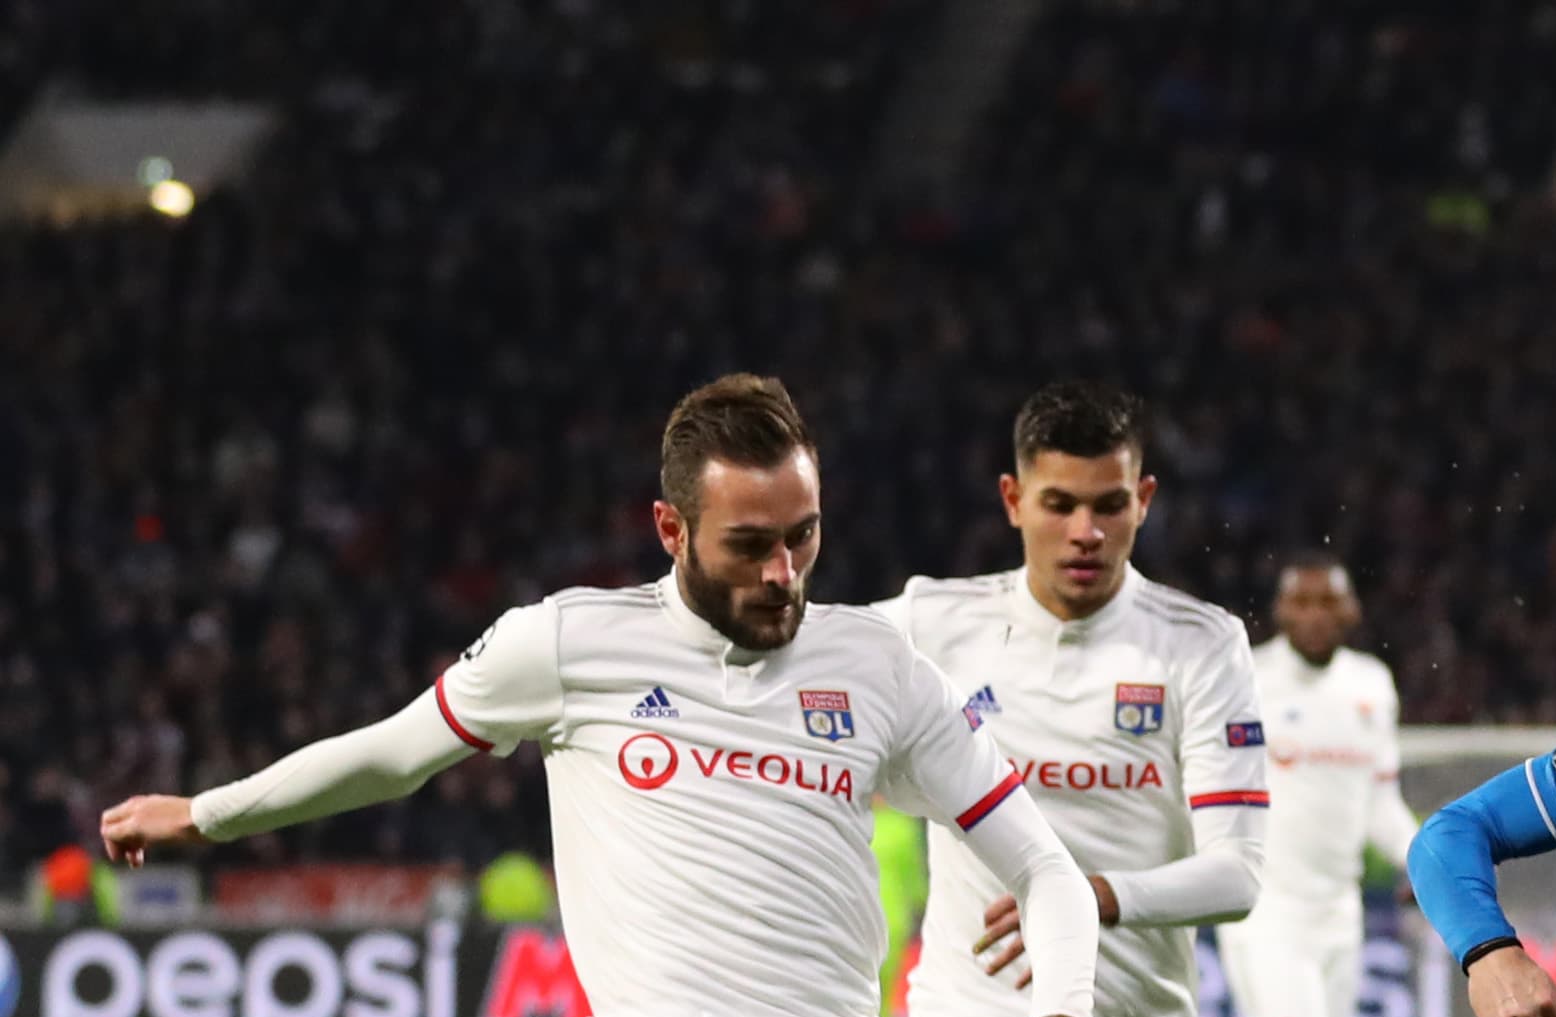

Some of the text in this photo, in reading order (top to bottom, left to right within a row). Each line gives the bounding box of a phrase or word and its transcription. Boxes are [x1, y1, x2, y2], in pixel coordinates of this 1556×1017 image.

[630, 705, 680, 719] adidas
[690, 748, 853, 803] VEOLIA
[1008, 757, 1162, 790] VEOLIA
